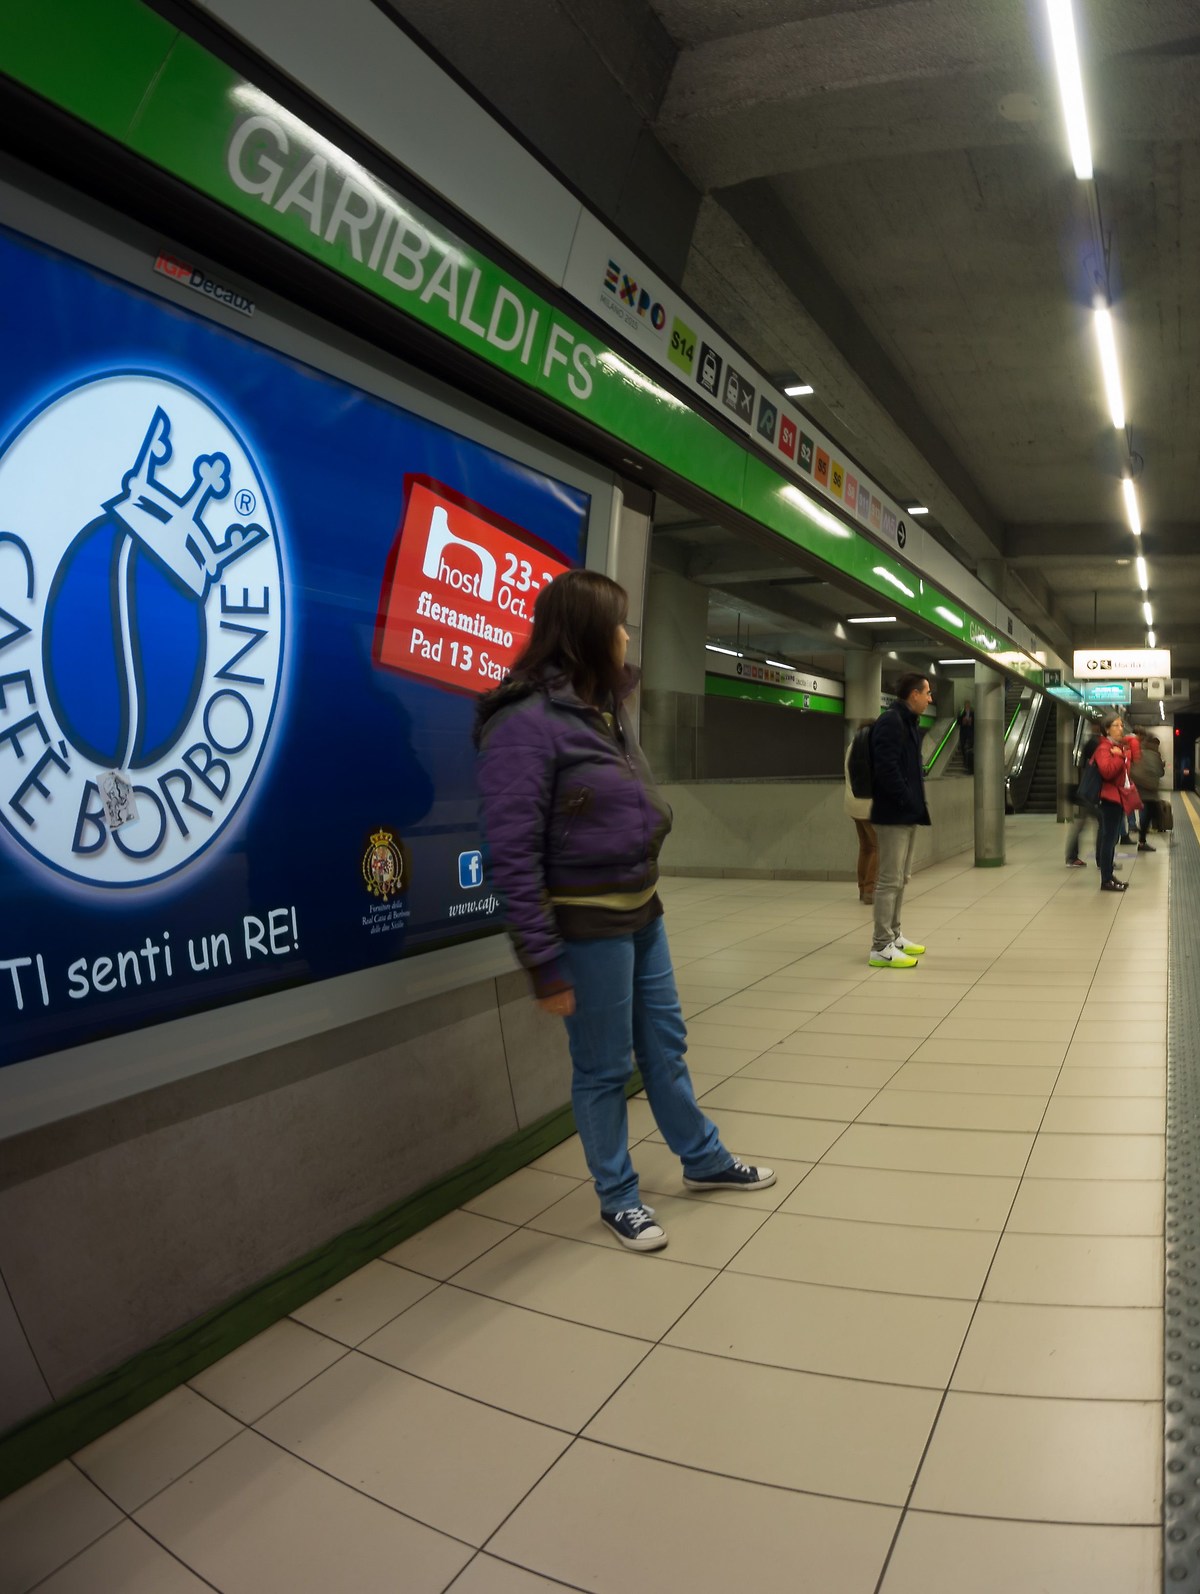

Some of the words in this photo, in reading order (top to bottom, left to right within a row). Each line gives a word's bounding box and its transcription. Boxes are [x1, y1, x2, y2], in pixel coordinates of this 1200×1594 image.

[228, 115, 539, 365] GARIBALDI
[543, 322, 597, 400] FS
[600, 293, 625, 319] MILANO
[603, 259, 666, 331] EXPO
[671, 330, 694, 362] S14
[782, 427, 794, 448] S1
[800, 443, 812, 464] S2
[817, 458, 827, 475] S5
[832, 471, 842, 488] S6
[883, 512, 896, 535] M5
[438, 557, 480, 598] host
[416, 591, 513, 648] fieramilano
[497, 585, 527, 621] Oct.
[409, 628, 443, 662] Pad
[449, 641, 473, 671] 13
[72, 584, 269, 859] BORBONE
[0, 953, 49, 1010] TI
[68, 931, 172, 999] senti
[188, 933, 232, 972] un
[243, 906, 299, 960] RE!
